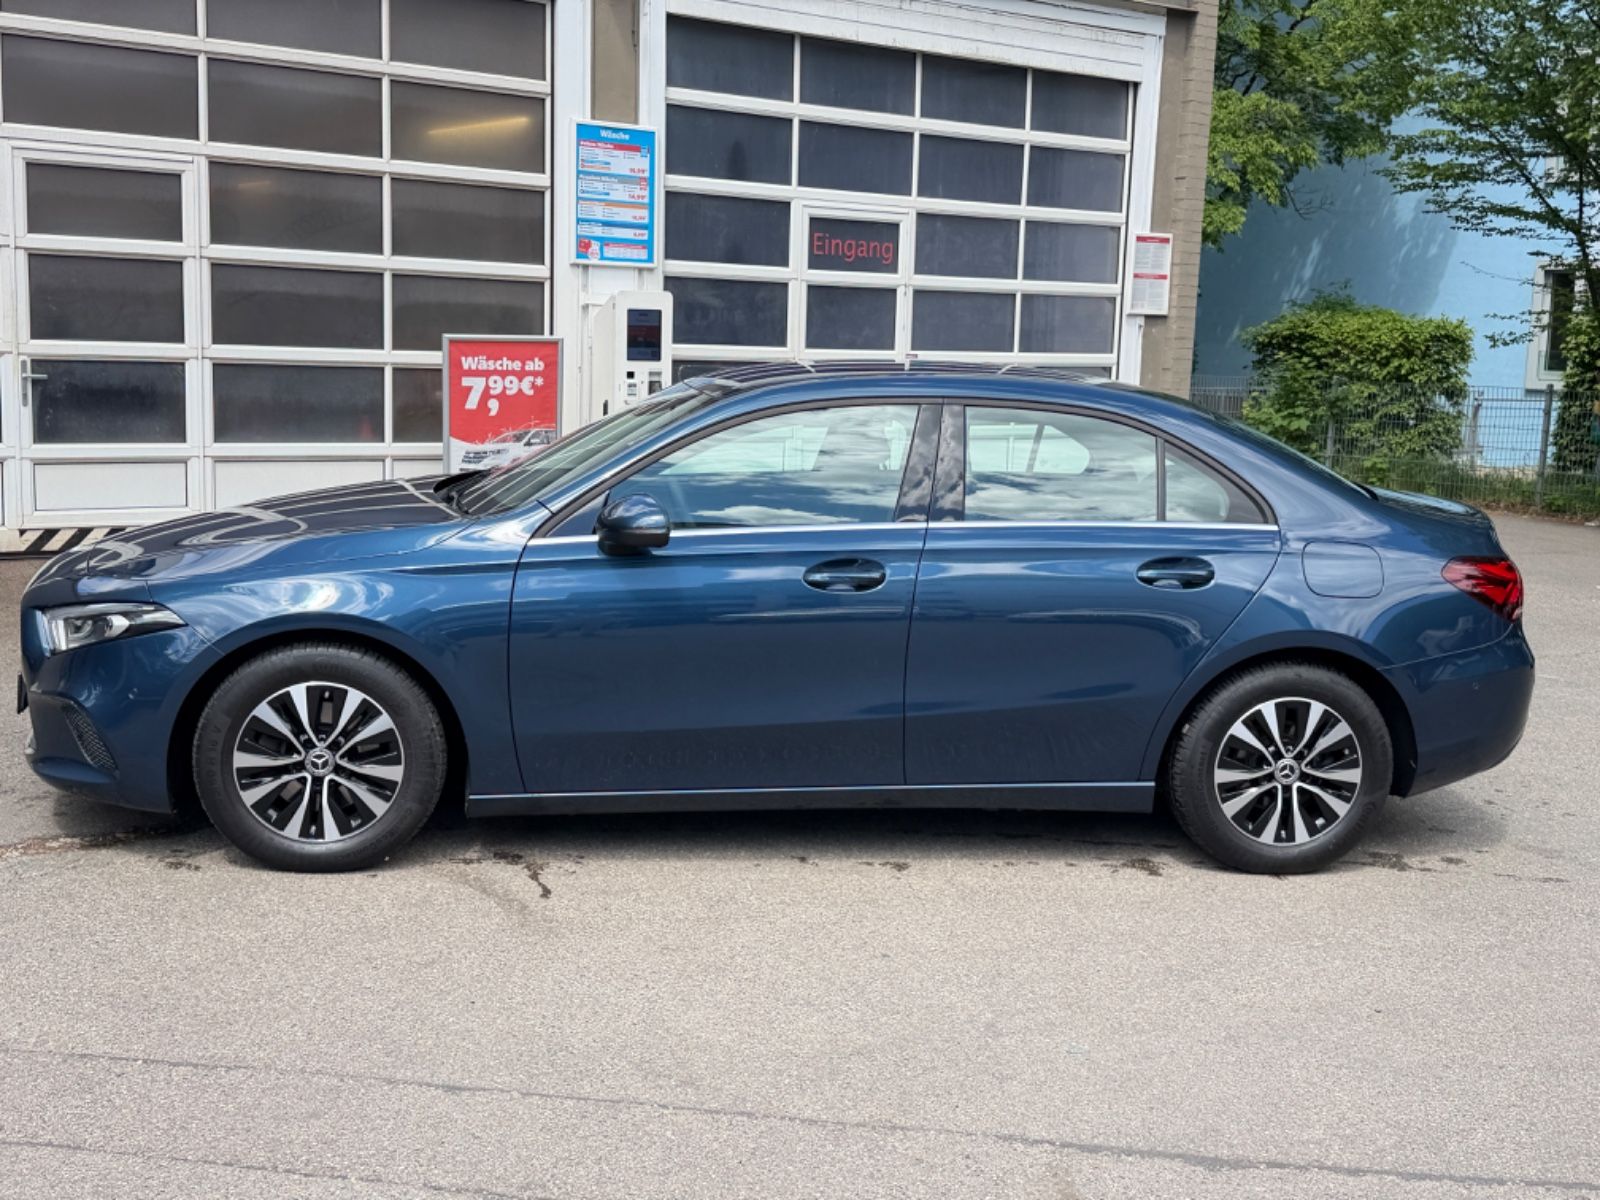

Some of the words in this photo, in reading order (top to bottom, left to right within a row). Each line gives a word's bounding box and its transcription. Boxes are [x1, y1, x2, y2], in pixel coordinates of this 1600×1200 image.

[813, 232, 893, 264] Eingang
[461, 356, 521, 370] Wäsche
[525, 357, 544, 370] ab
